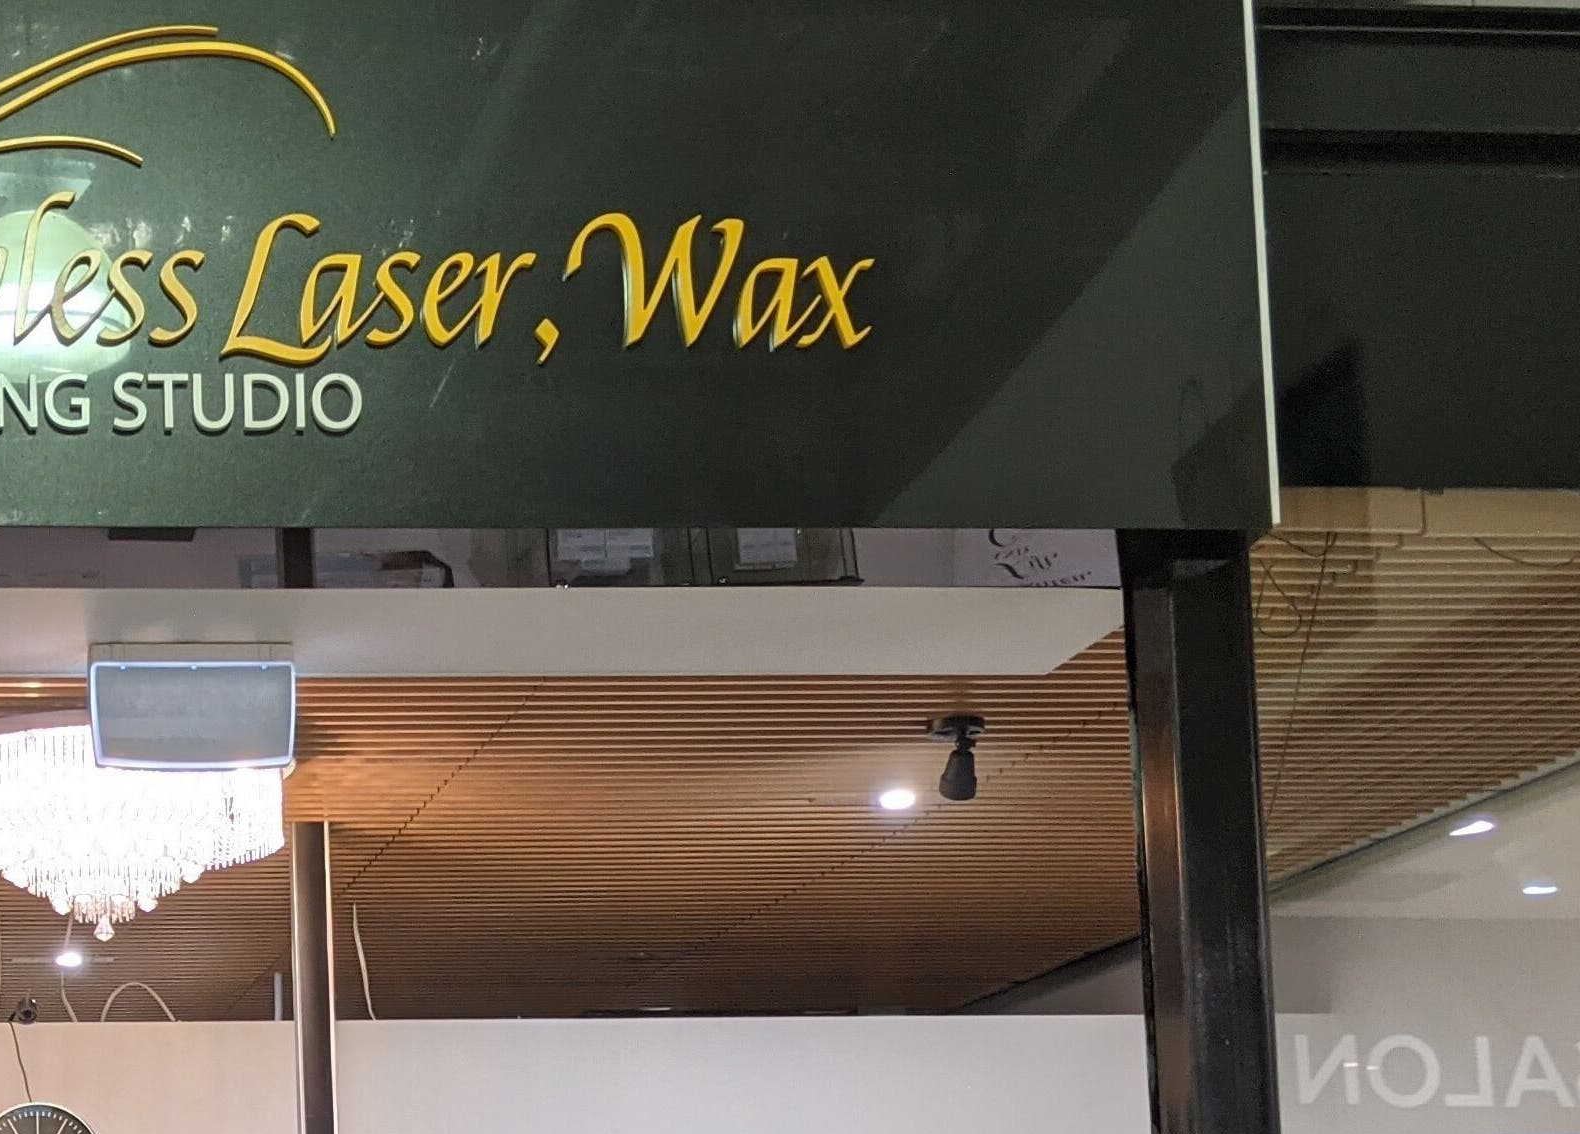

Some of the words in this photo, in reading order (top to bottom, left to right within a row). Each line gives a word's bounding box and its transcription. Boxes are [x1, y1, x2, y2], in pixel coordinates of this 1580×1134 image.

[219, 213, 558, 368] Laser,
[564, 212, 874, 352] Wax
[112, 371, 364, 436] STUDIO
